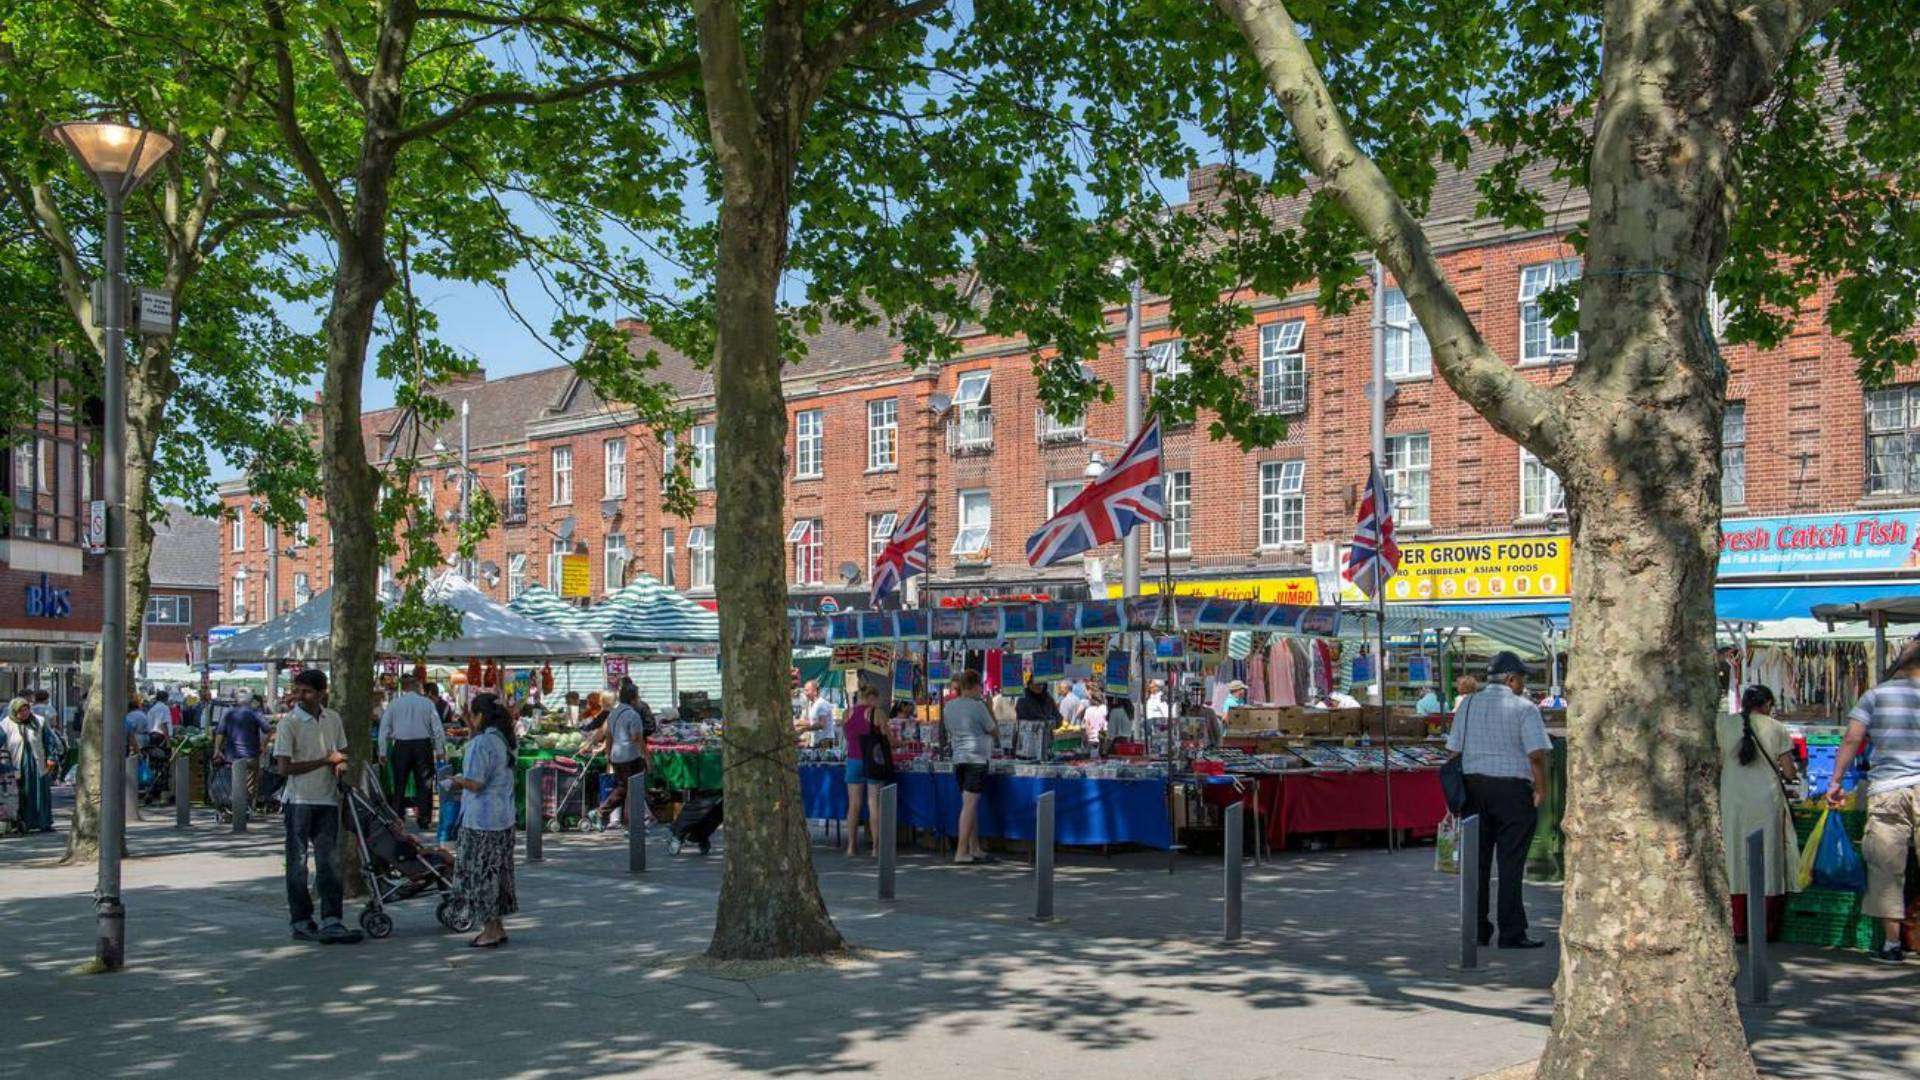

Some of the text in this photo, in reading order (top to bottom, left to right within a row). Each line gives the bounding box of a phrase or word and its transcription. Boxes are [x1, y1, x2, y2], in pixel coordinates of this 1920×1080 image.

[1719, 517, 1908, 552] resh Catch Fish
[1430, 545, 1491, 563] GROWS
[1498, 542, 1558, 560] FOODS
[1473, 565, 1502, 574] ASIAN
[1507, 563, 1539, 573] FOODS
[1274, 591, 1312, 604] JUMBO
